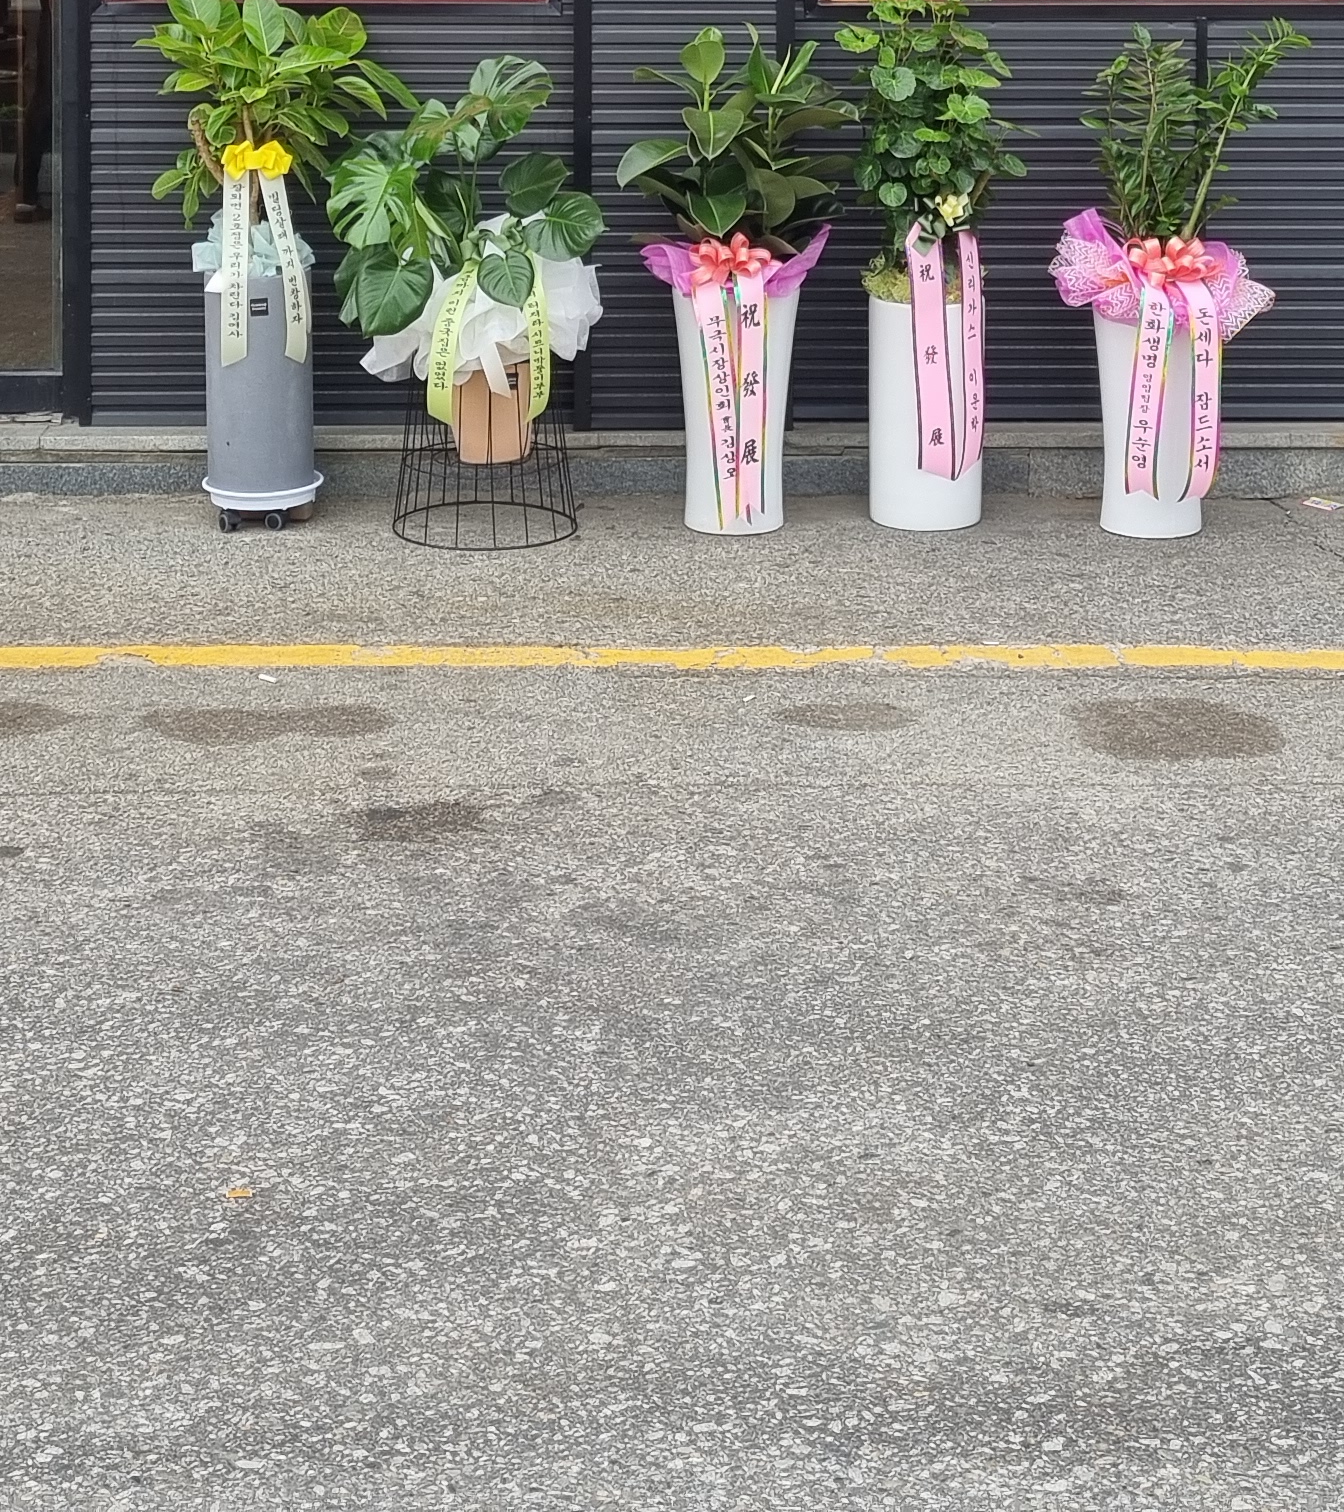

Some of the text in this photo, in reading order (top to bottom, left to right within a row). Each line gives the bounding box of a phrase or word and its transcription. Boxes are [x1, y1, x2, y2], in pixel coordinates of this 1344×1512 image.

[1141, 301, 1167, 369] 한화생명
[1193, 307, 1214, 473] 돈세다 잠드소서
